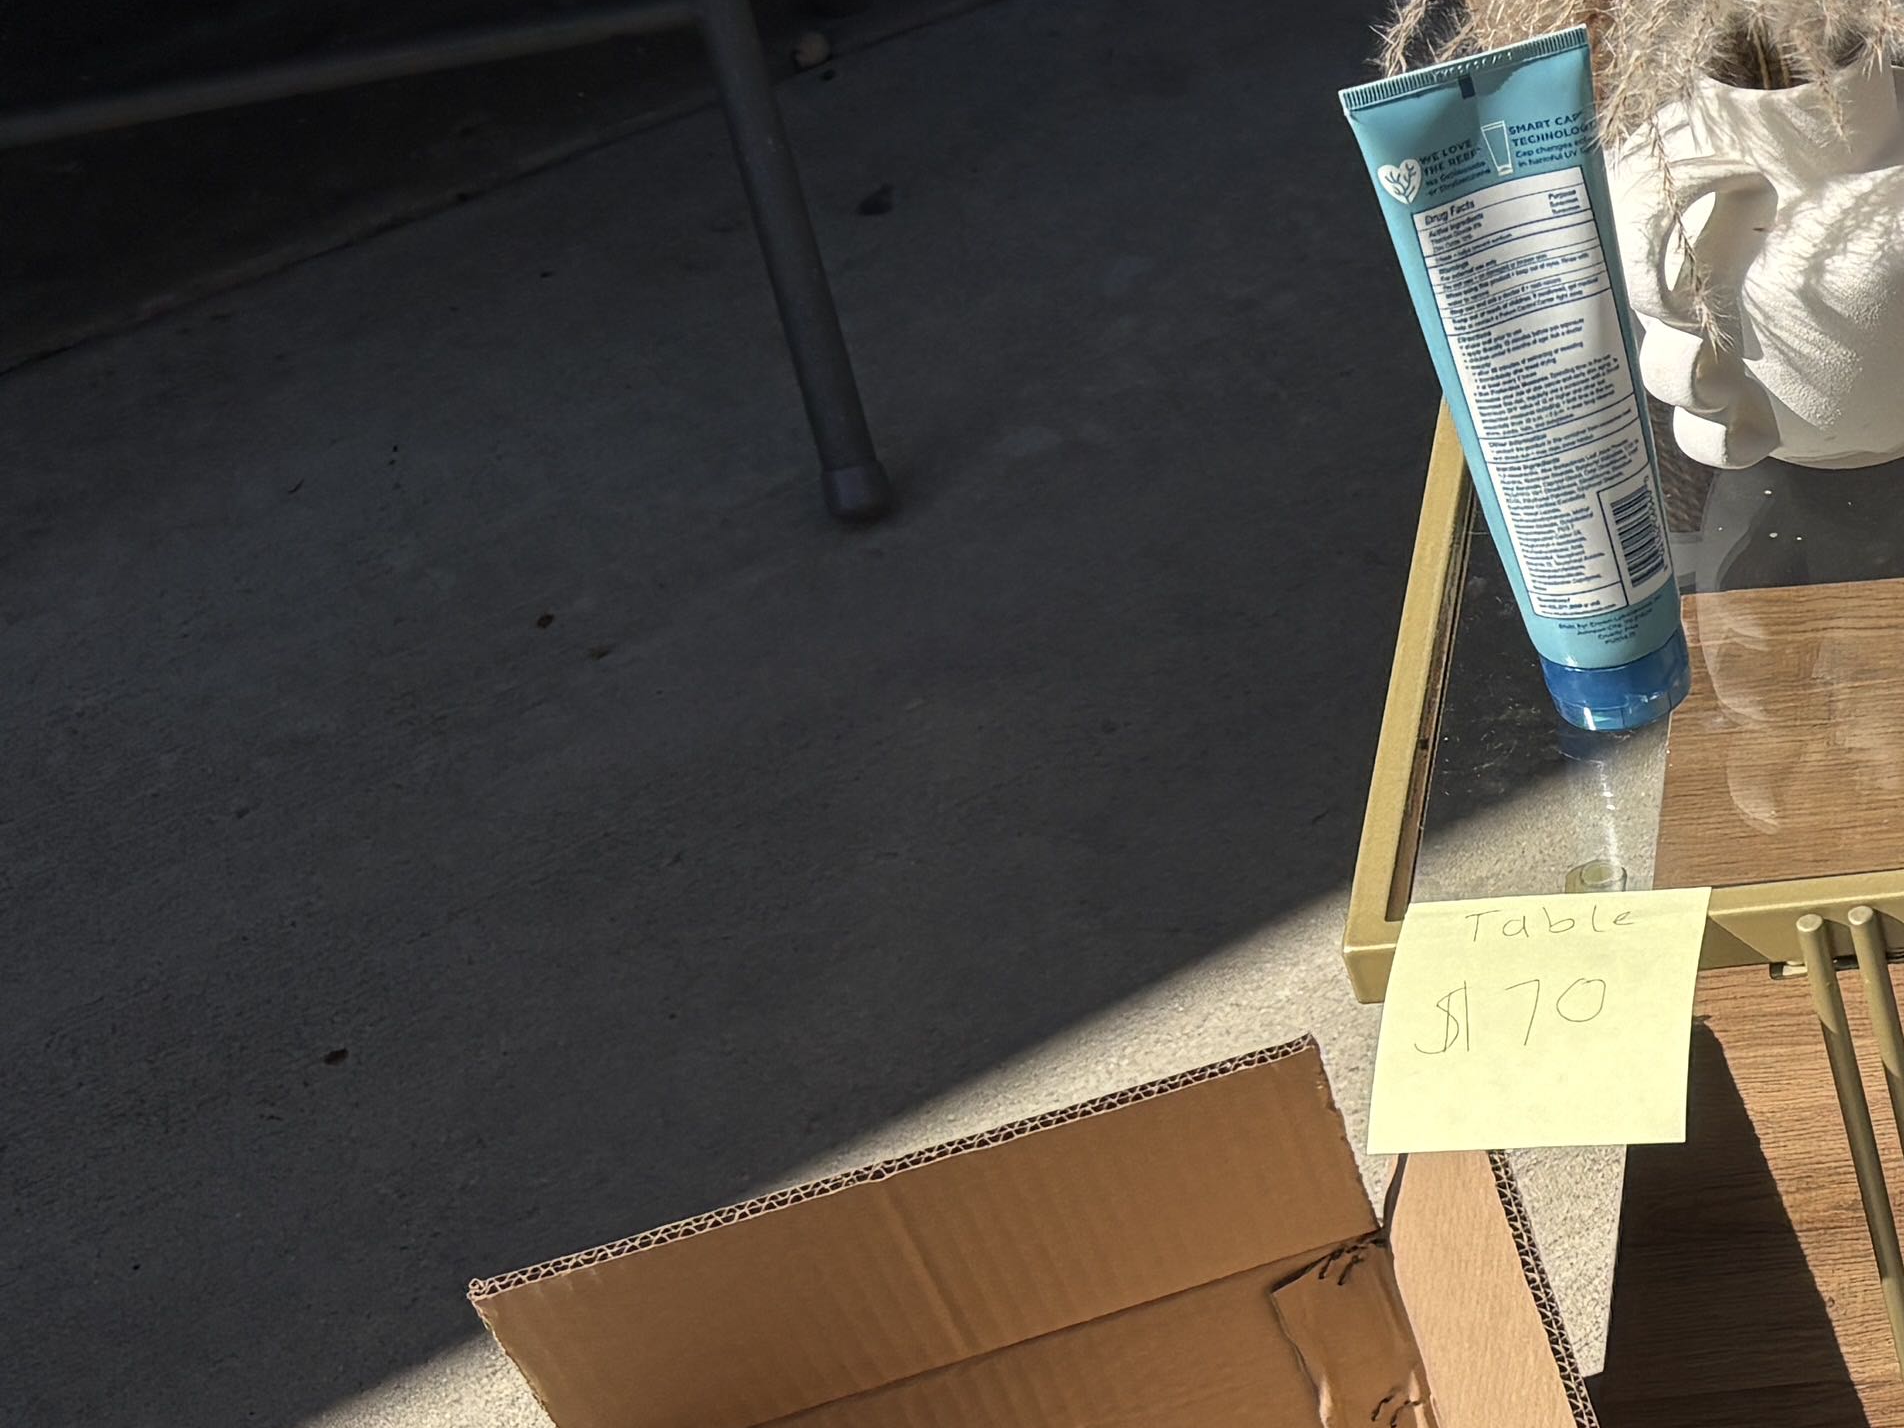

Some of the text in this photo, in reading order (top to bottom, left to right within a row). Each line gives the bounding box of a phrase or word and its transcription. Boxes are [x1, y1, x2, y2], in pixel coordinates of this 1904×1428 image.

[1509, 119, 1551, 135] SMART
[1442, 139, 1473, 159] LOVE
[1424, 200, 1475, 226] Drug Facts
[1465, 905, 1635, 942] Table
